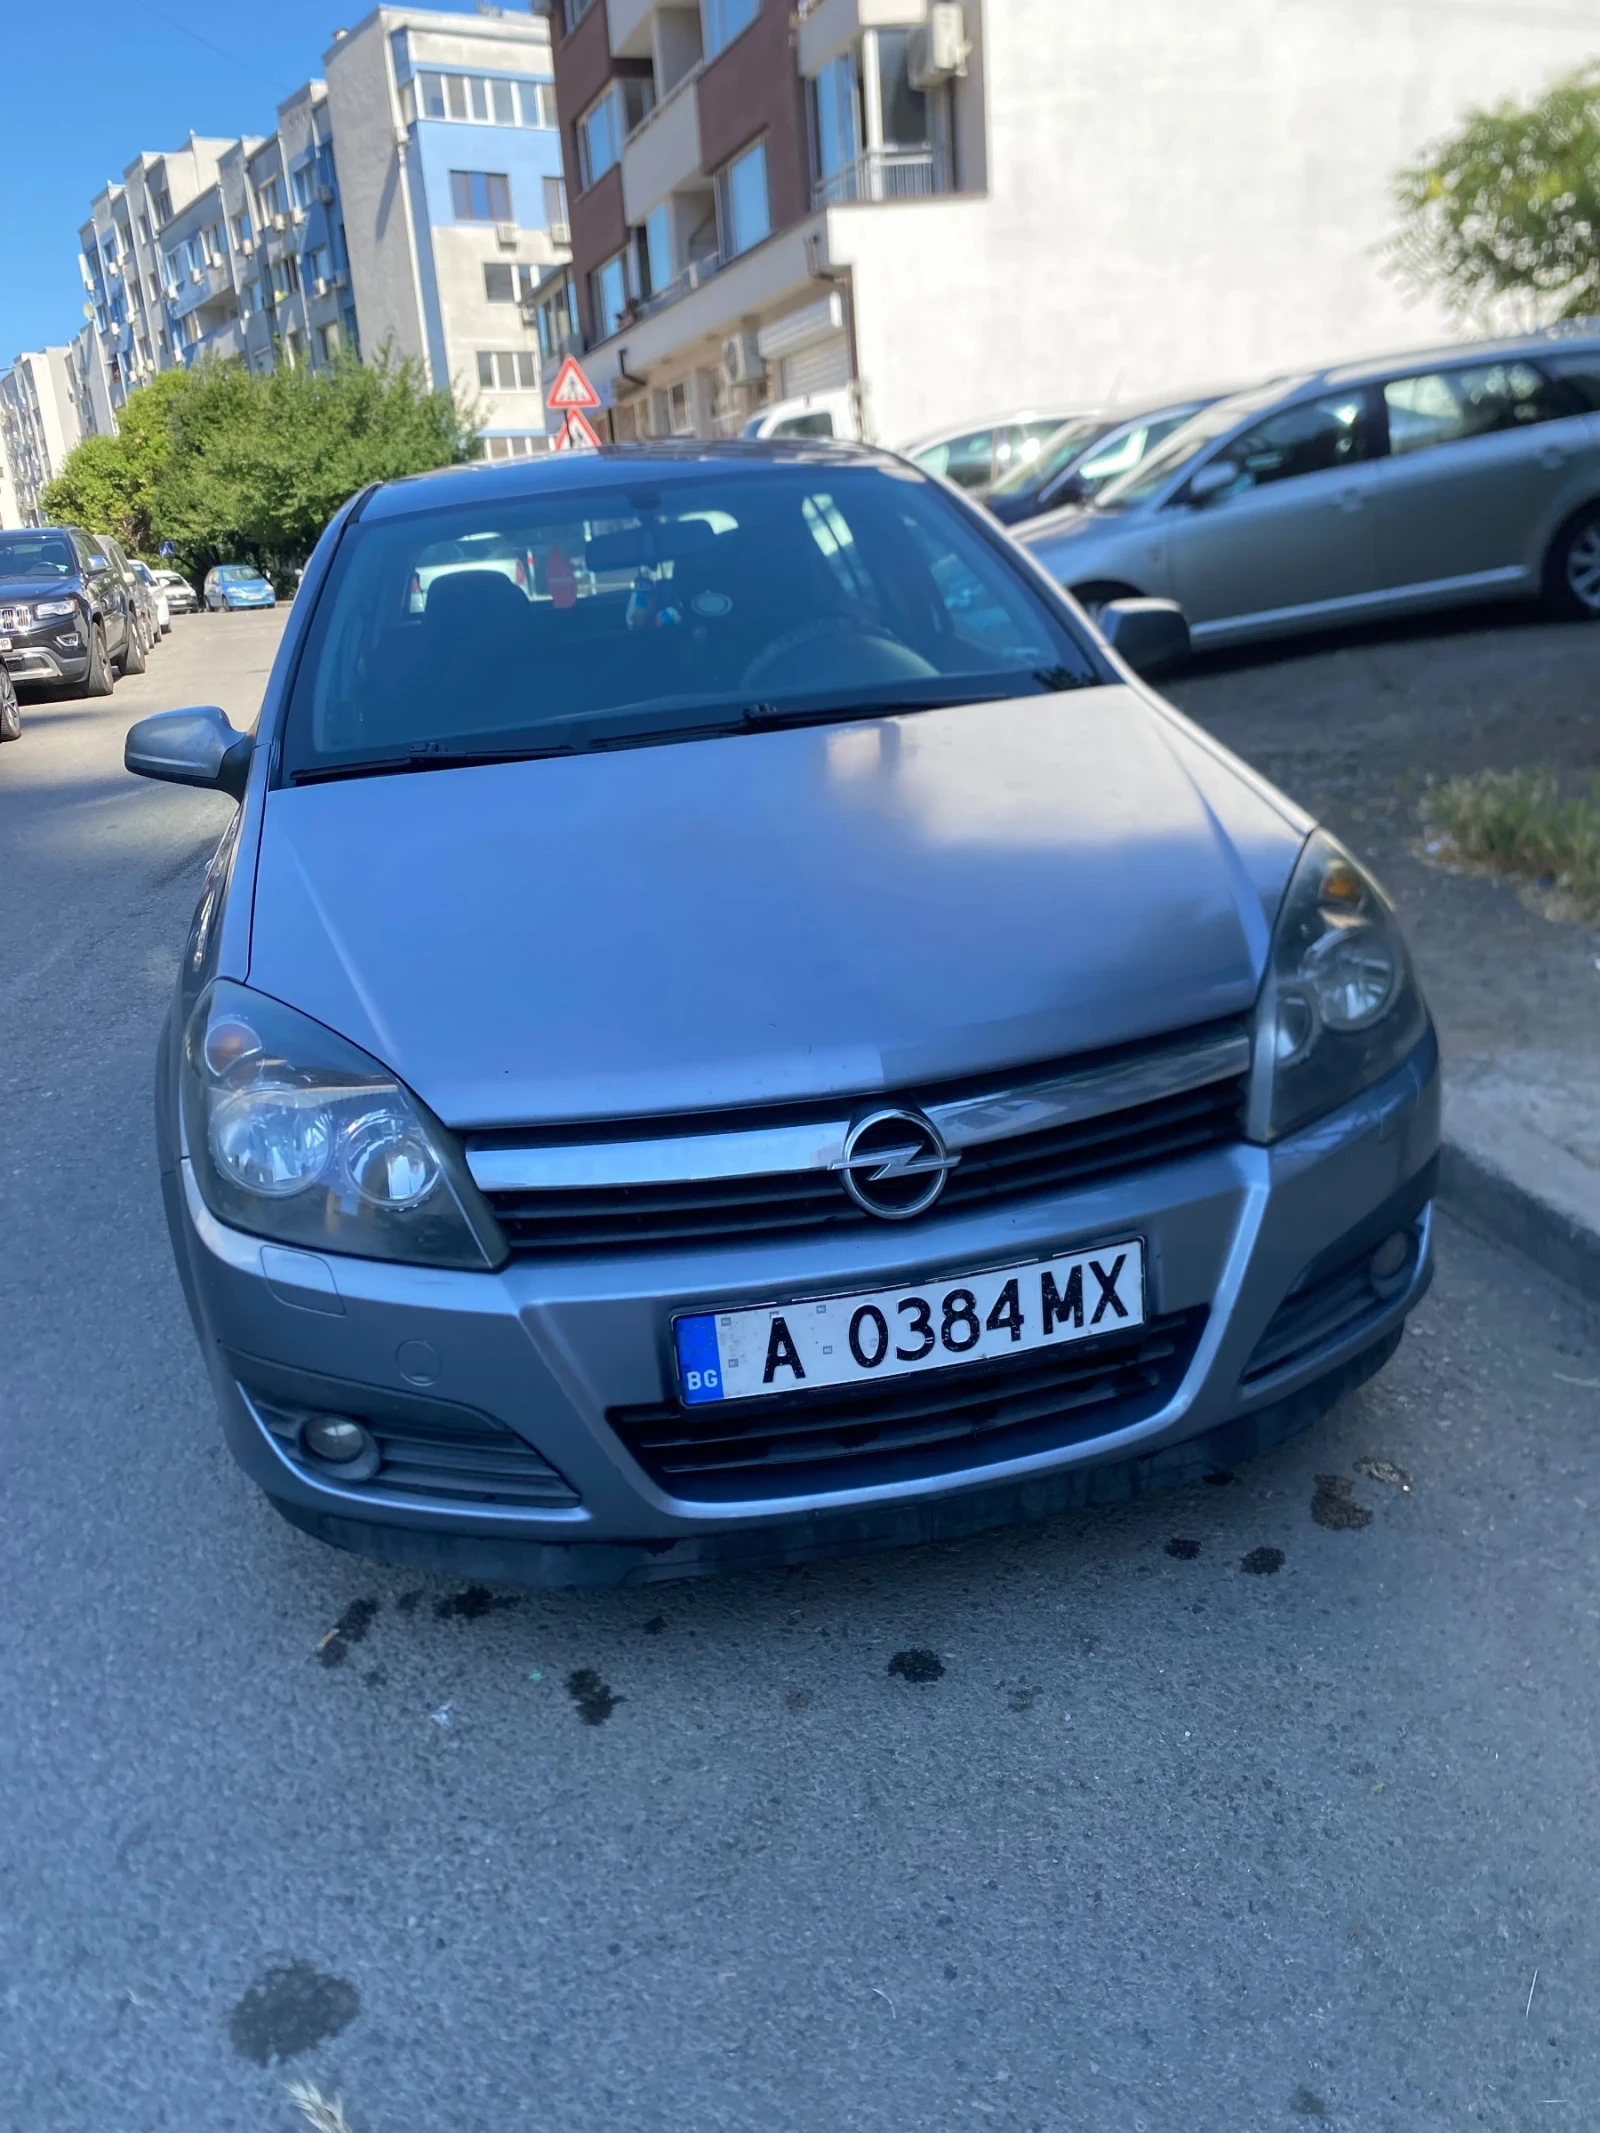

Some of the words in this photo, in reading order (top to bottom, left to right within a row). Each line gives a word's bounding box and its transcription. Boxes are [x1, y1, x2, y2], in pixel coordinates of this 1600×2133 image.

[763, 1316, 806, 1383] A
[848, 1278, 1025, 1368] 0384
[1040, 1254, 1129, 1335] MX
[687, 1369, 718, 1390] BG
